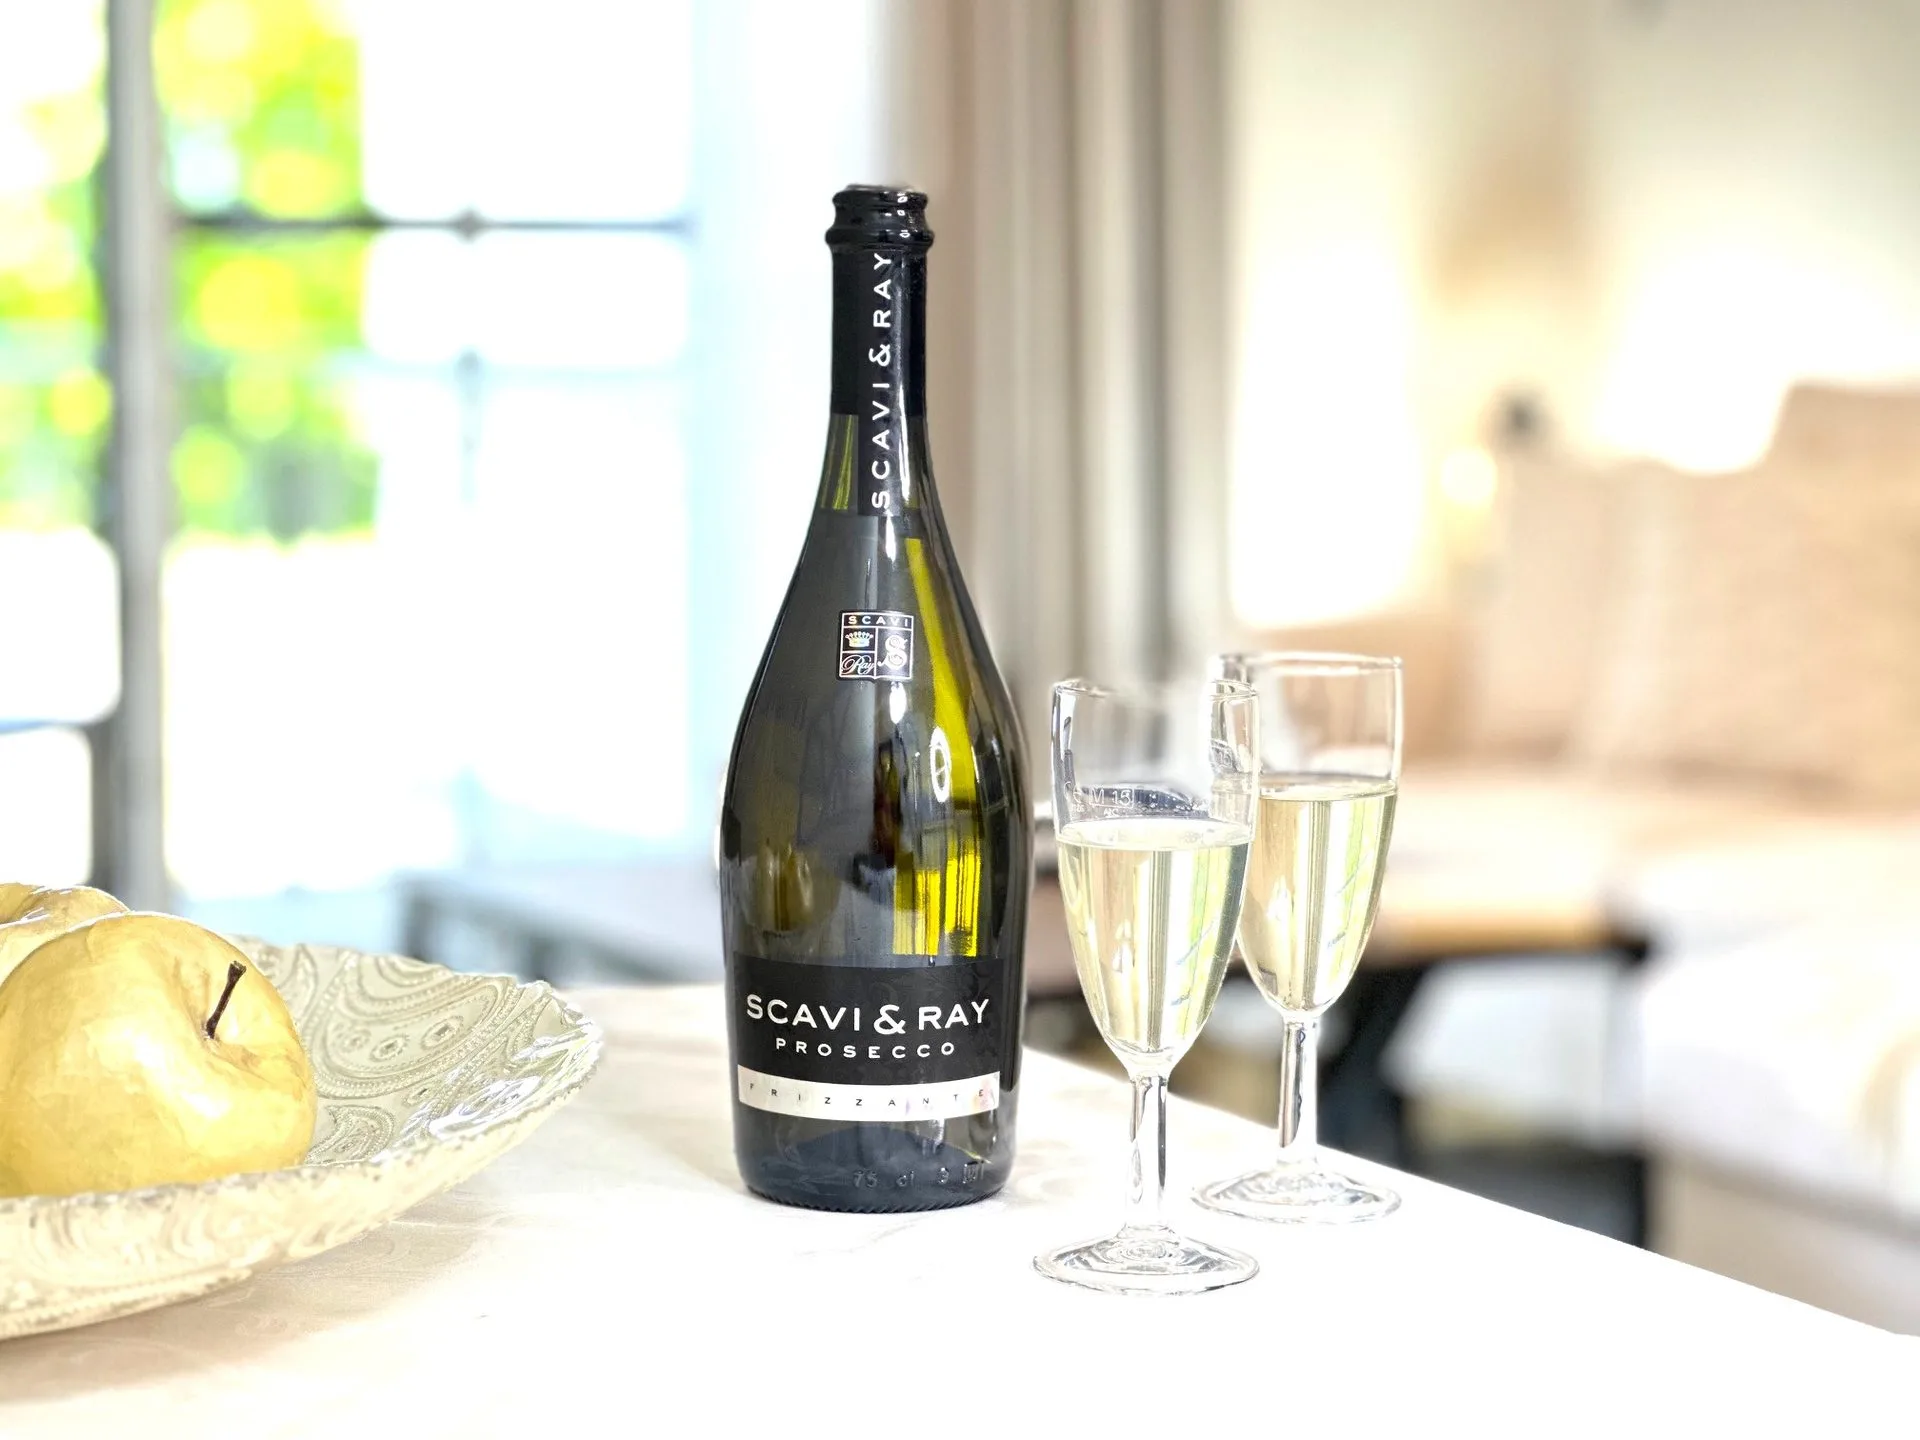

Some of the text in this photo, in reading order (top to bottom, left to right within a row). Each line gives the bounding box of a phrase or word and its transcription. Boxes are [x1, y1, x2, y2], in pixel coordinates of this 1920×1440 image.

[868, 252, 892, 510] SCAVI & RAY
[847, 615, 909, 627] SCAVI
[841, 654, 876, 676] Ray
[1088, 786, 1105, 805] M
[746, 993, 990, 1035] SCAVI & RAY
[775, 1037, 955, 1060] PROSECCO
[749, 1082, 985, 1107] FRIZZANTE
